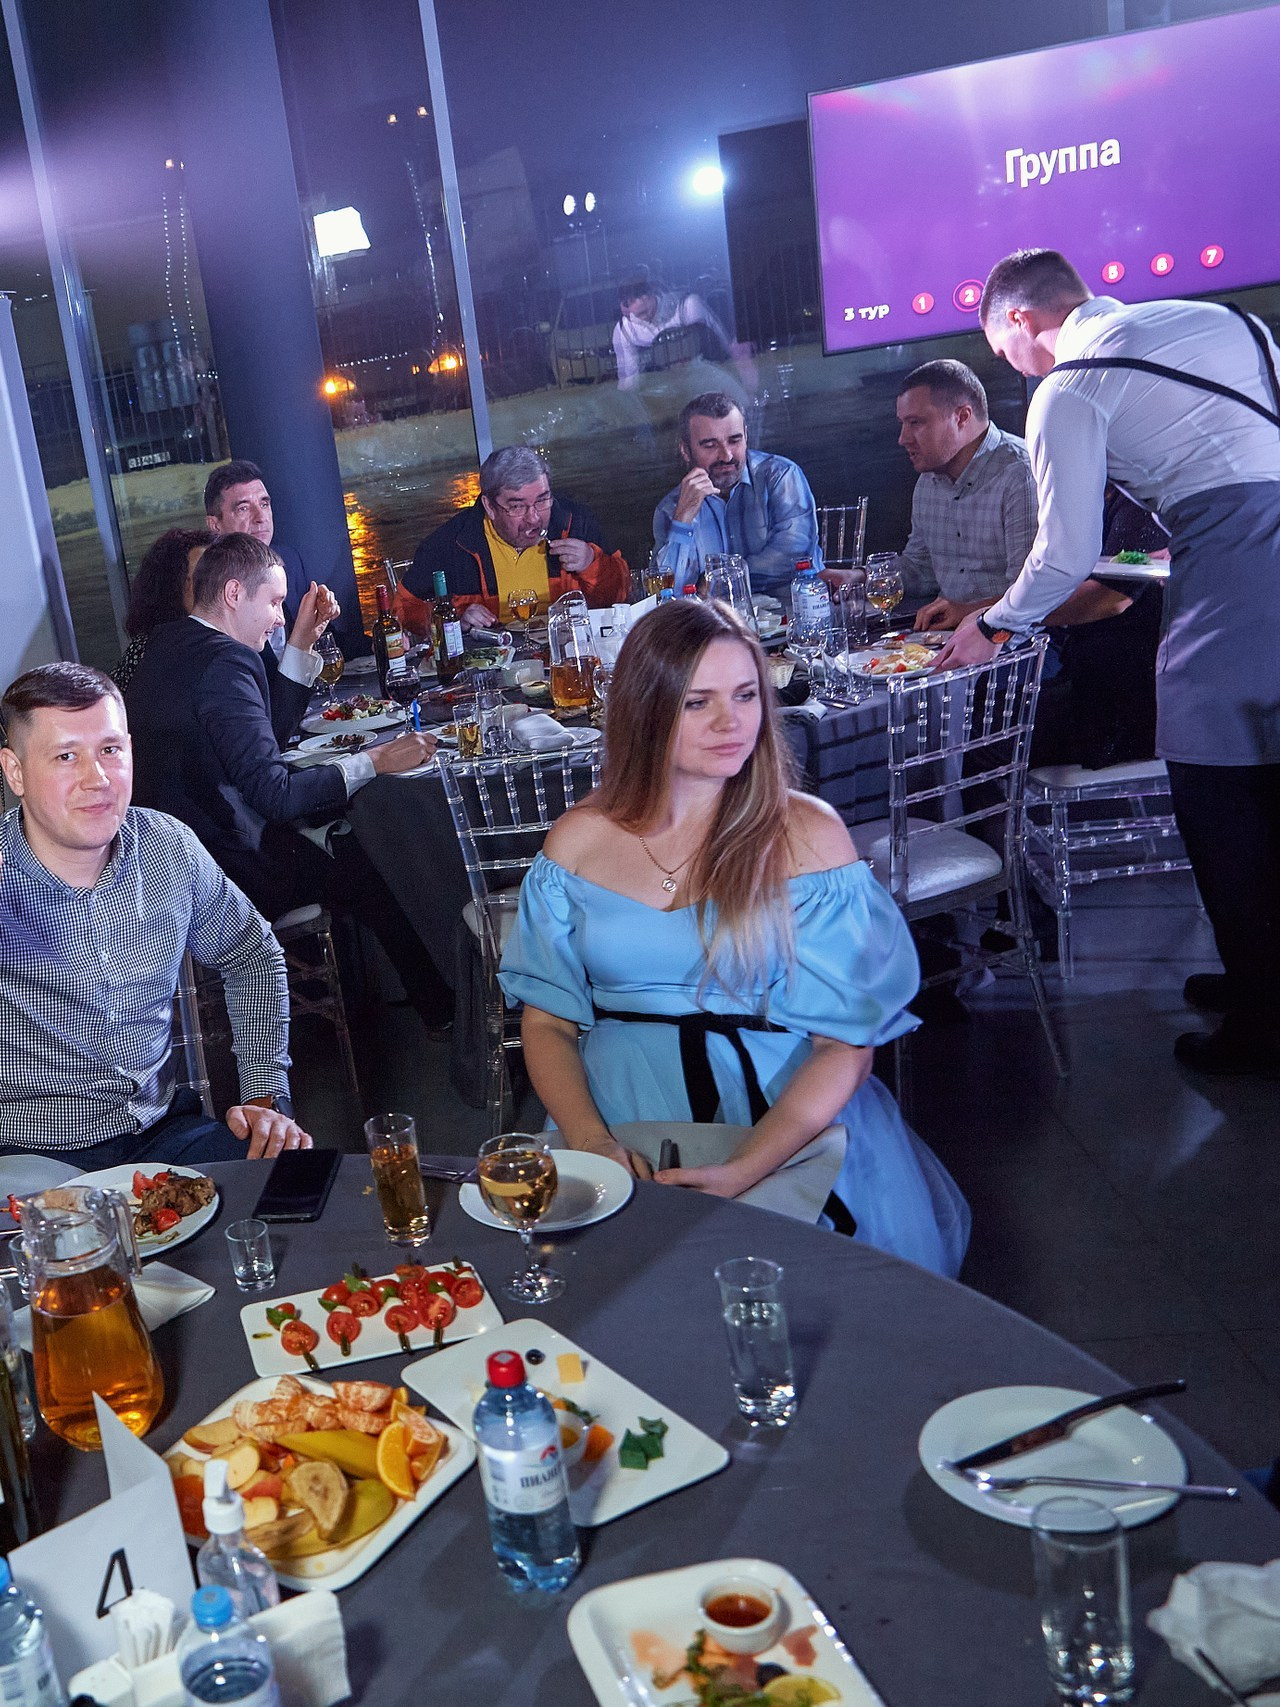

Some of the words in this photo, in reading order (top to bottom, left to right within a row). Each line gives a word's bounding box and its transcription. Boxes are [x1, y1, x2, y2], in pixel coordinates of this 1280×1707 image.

[1005, 138, 1121, 188] Группа
[1108, 265, 1119, 280] 5
[1156, 257, 1168, 272] 6
[1206, 248, 1218, 264] 7
[844, 307, 855, 321] 3
[858, 304, 890, 321] тур
[918, 296, 926, 310] 1
[964, 288, 975, 303] 2
